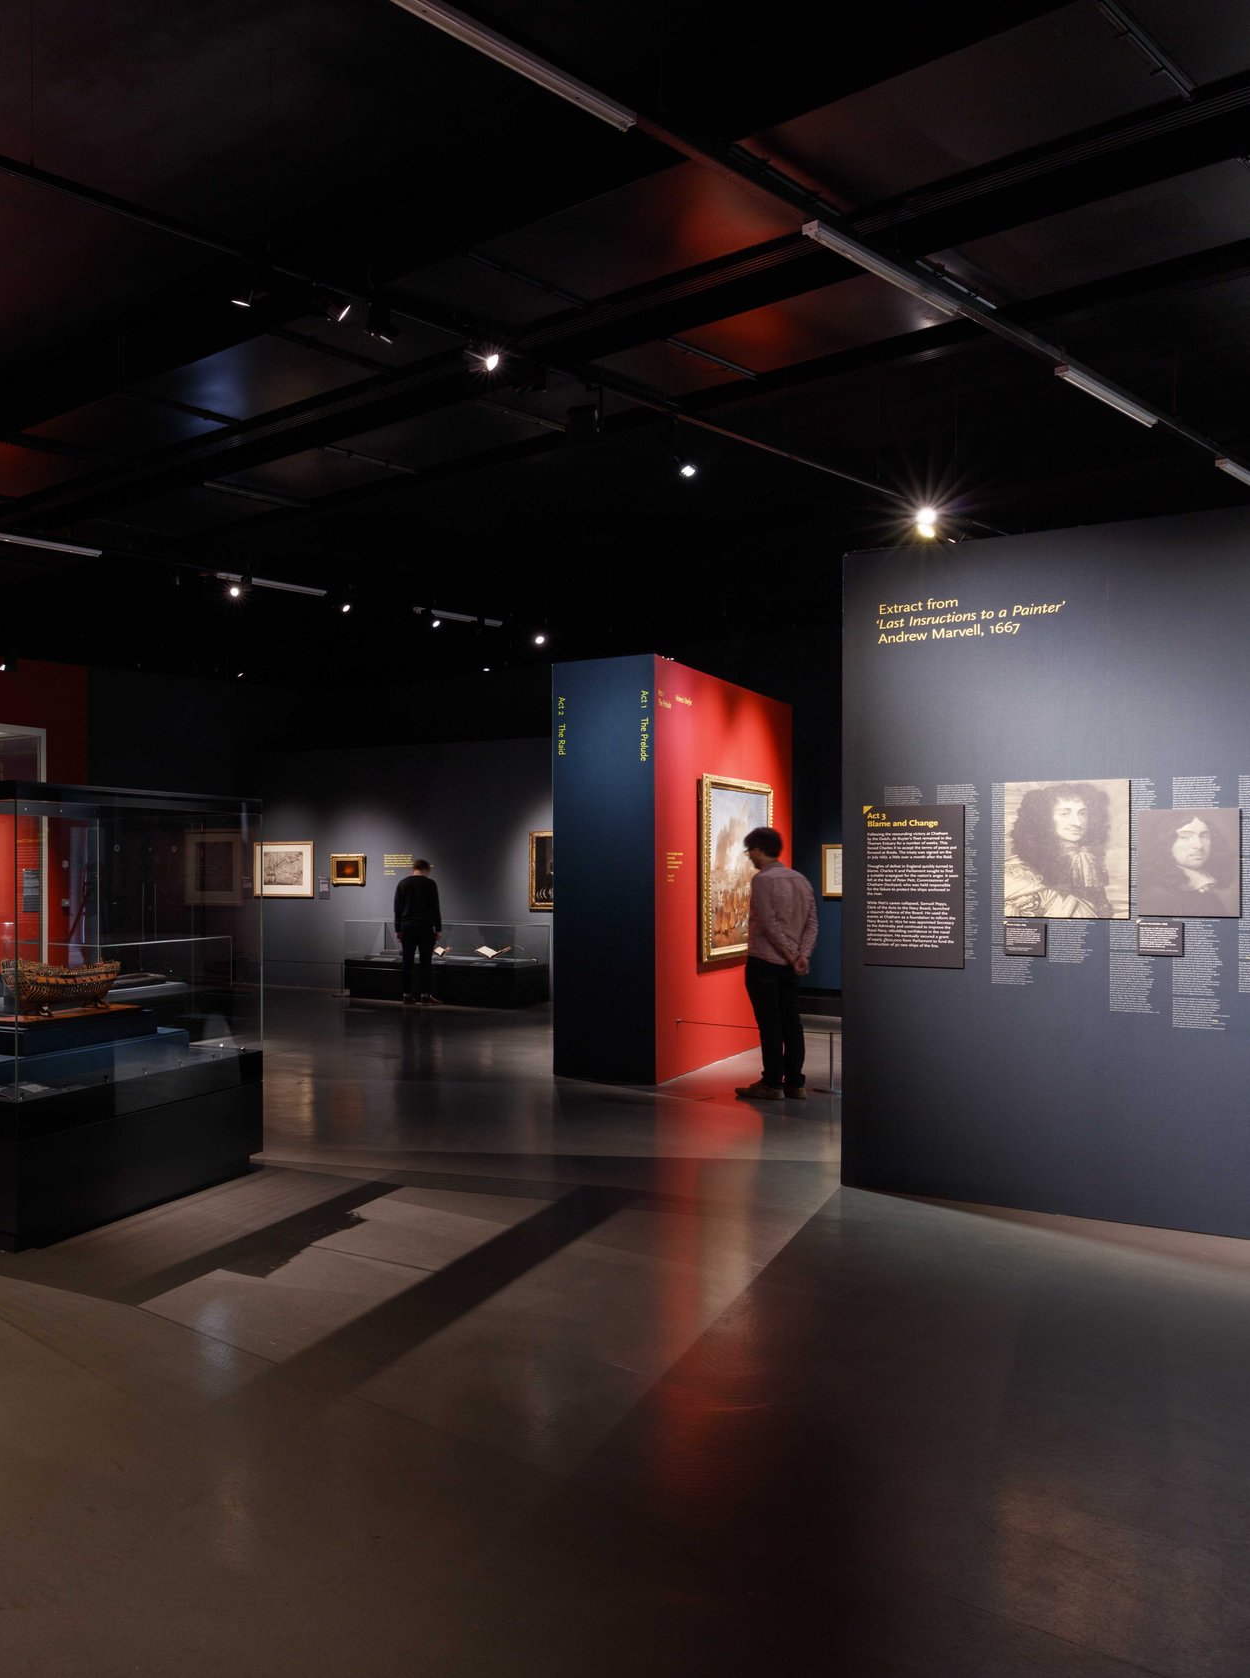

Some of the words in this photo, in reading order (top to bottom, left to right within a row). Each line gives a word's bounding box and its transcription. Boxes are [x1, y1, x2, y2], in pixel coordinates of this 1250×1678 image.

[879, 601, 923, 615] Extract
[927, 597, 959, 610] from
[909, 611, 977, 627] Insructions
[981, 609, 994, 620] to
[998, 609, 1007, 618] a
[878, 631, 928, 645] Andrew
[932, 623, 985, 640] Marvell,
[989, 621, 1021, 635] 1667
[558, 696, 566, 709] Act
[640, 690, 649, 703] Act
[558, 723, 566, 738] The
[640, 717, 649, 732] The
[558, 739, 566, 755] Raid
[640, 733, 649, 762] Prelude
[909, 819, 939, 828] Change
